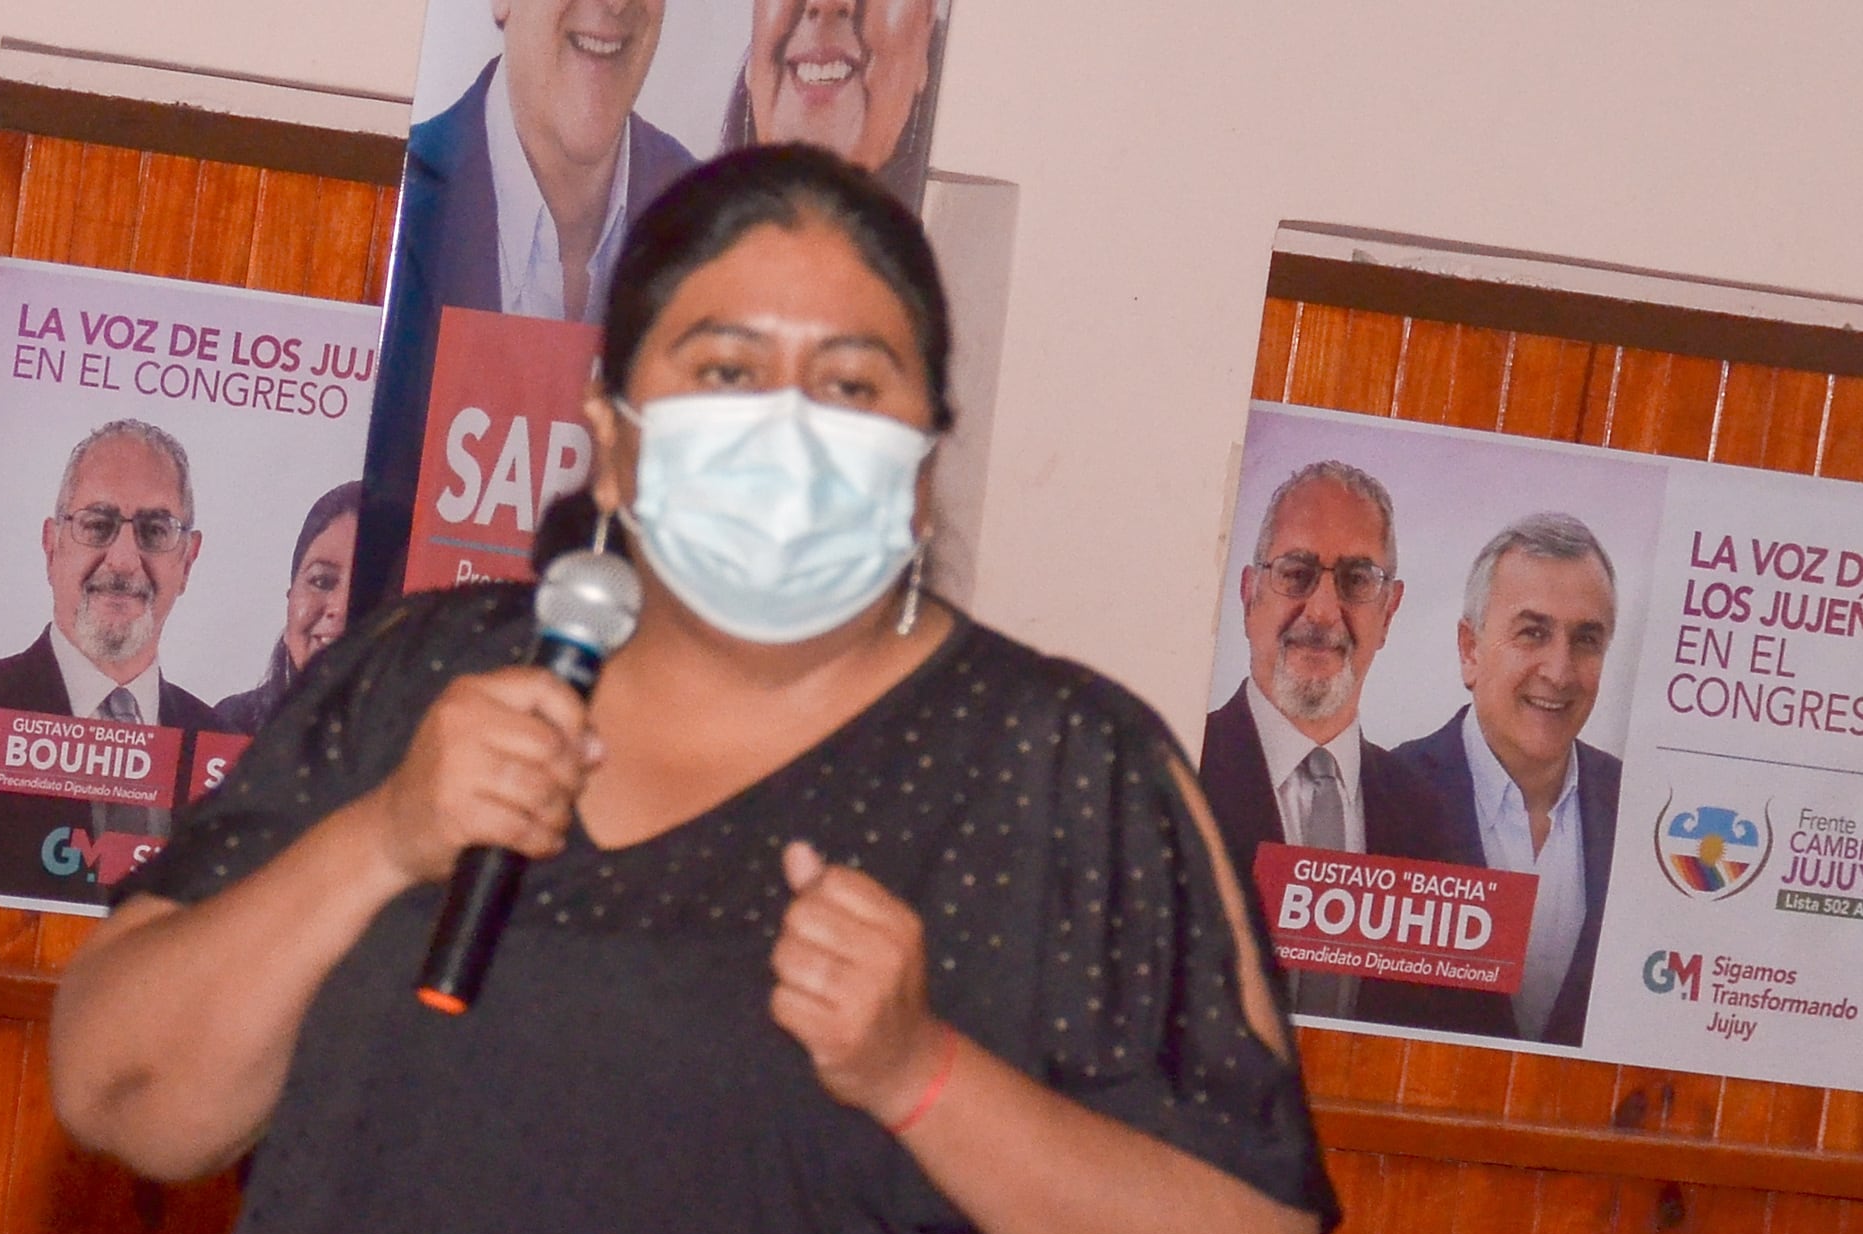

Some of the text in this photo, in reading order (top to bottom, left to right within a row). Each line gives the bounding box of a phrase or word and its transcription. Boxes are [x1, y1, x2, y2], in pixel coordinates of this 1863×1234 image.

[17, 303, 66, 343] LA
[80, 310, 160, 354] VOZ
[169, 322, 221, 363] DE
[231, 331, 303, 374] LOS
[12, 344, 349, 421] EN EL CONGRESO
[1690, 530, 1738, 573] LA
[1752, 538, 1829, 585] VOZ
[1683, 578, 1755, 623] LOS
[1675, 624, 1796, 679] EN EL
[12, 717, 155, 747] GUSTAVO "BACHA"
[5, 734, 152, 780] BOUHID
[64, 780, 111, 797] Diputado
[112, 785, 158, 801] Nacional
[1799, 808, 1857, 835] Frente
[1294, 859, 1498, 901] GUSTAVO "BACHA"
[1781, 855, 1863, 891] JUJU
[1278, 883, 1493, 951] BOUHID
[1784, 892, 1820, 912] Lista
[1823, 898, 1850, 915] 502
[1364, 951, 1433, 975] Diputado
[1436, 960, 1500, 983] Nacional
[1712, 955, 1798, 985] Sigamos
[1711, 983, 1858, 1021] Transformando
[1706, 1012, 1758, 1042] Jujuy
